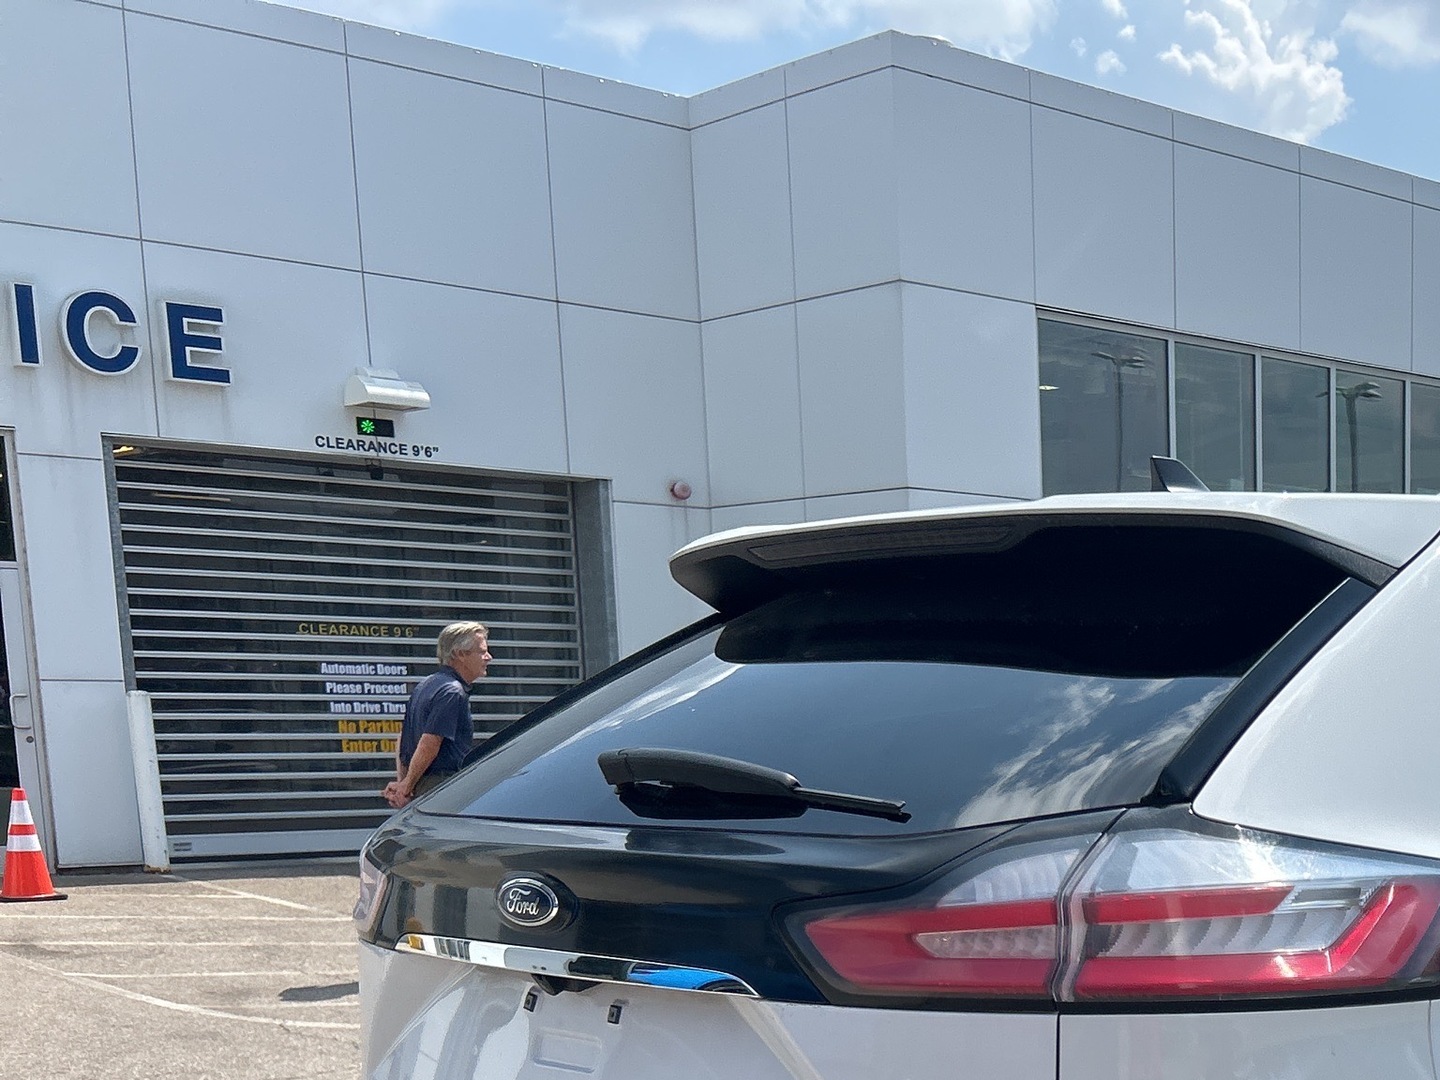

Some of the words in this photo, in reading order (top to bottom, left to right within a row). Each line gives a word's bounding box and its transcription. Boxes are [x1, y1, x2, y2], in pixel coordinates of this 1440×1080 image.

[12, 282, 232, 386] ICE
[315, 435, 408, 456] CLEARANCE
[298, 622, 389, 637] CLEARANCE
[321, 662, 375, 675] Automatic
[377, 663, 408, 676] Doors
[325, 682, 362, 694] Please
[364, 683, 407, 694] Proceed
[330, 702, 351, 713] Into
[353, 702, 380, 713] Drive
[382, 702, 406, 713] Thru
[338, 720, 356, 733] No
[342, 738, 377, 752] Enter
[506, 887, 540, 916] Ford
